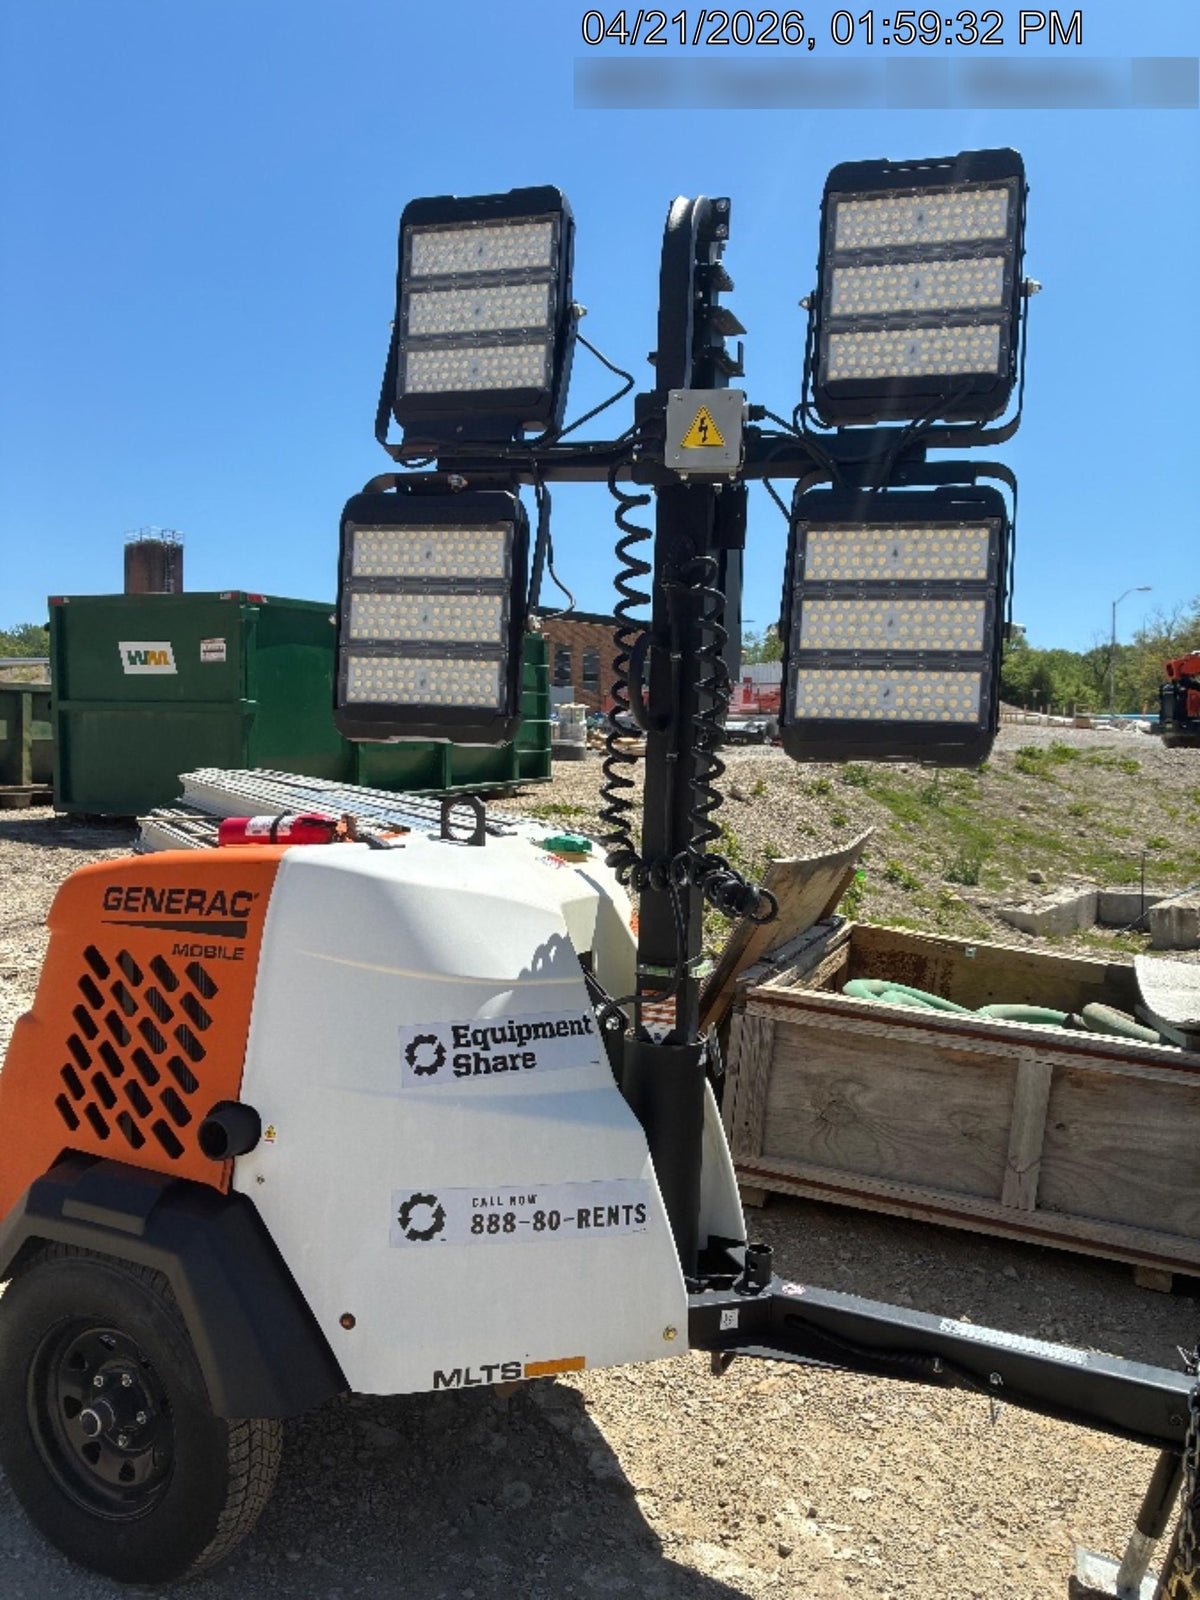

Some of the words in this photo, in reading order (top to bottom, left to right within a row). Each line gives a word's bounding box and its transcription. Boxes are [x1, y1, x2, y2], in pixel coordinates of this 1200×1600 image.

[127, 650, 170, 665] WM
[103, 886, 254, 918] GENERAC
[172, 943, 245, 960] MOBILE
[451, 1015, 594, 1051] Equipment
[452, 1052, 537, 1078] Share
[472, 1196, 504, 1208] CALL
[510, 1194, 538, 1206] NOW
[470, 1203, 647, 1235] 888-80-RENTS
[433, 1361, 522, 1389] MLTS
